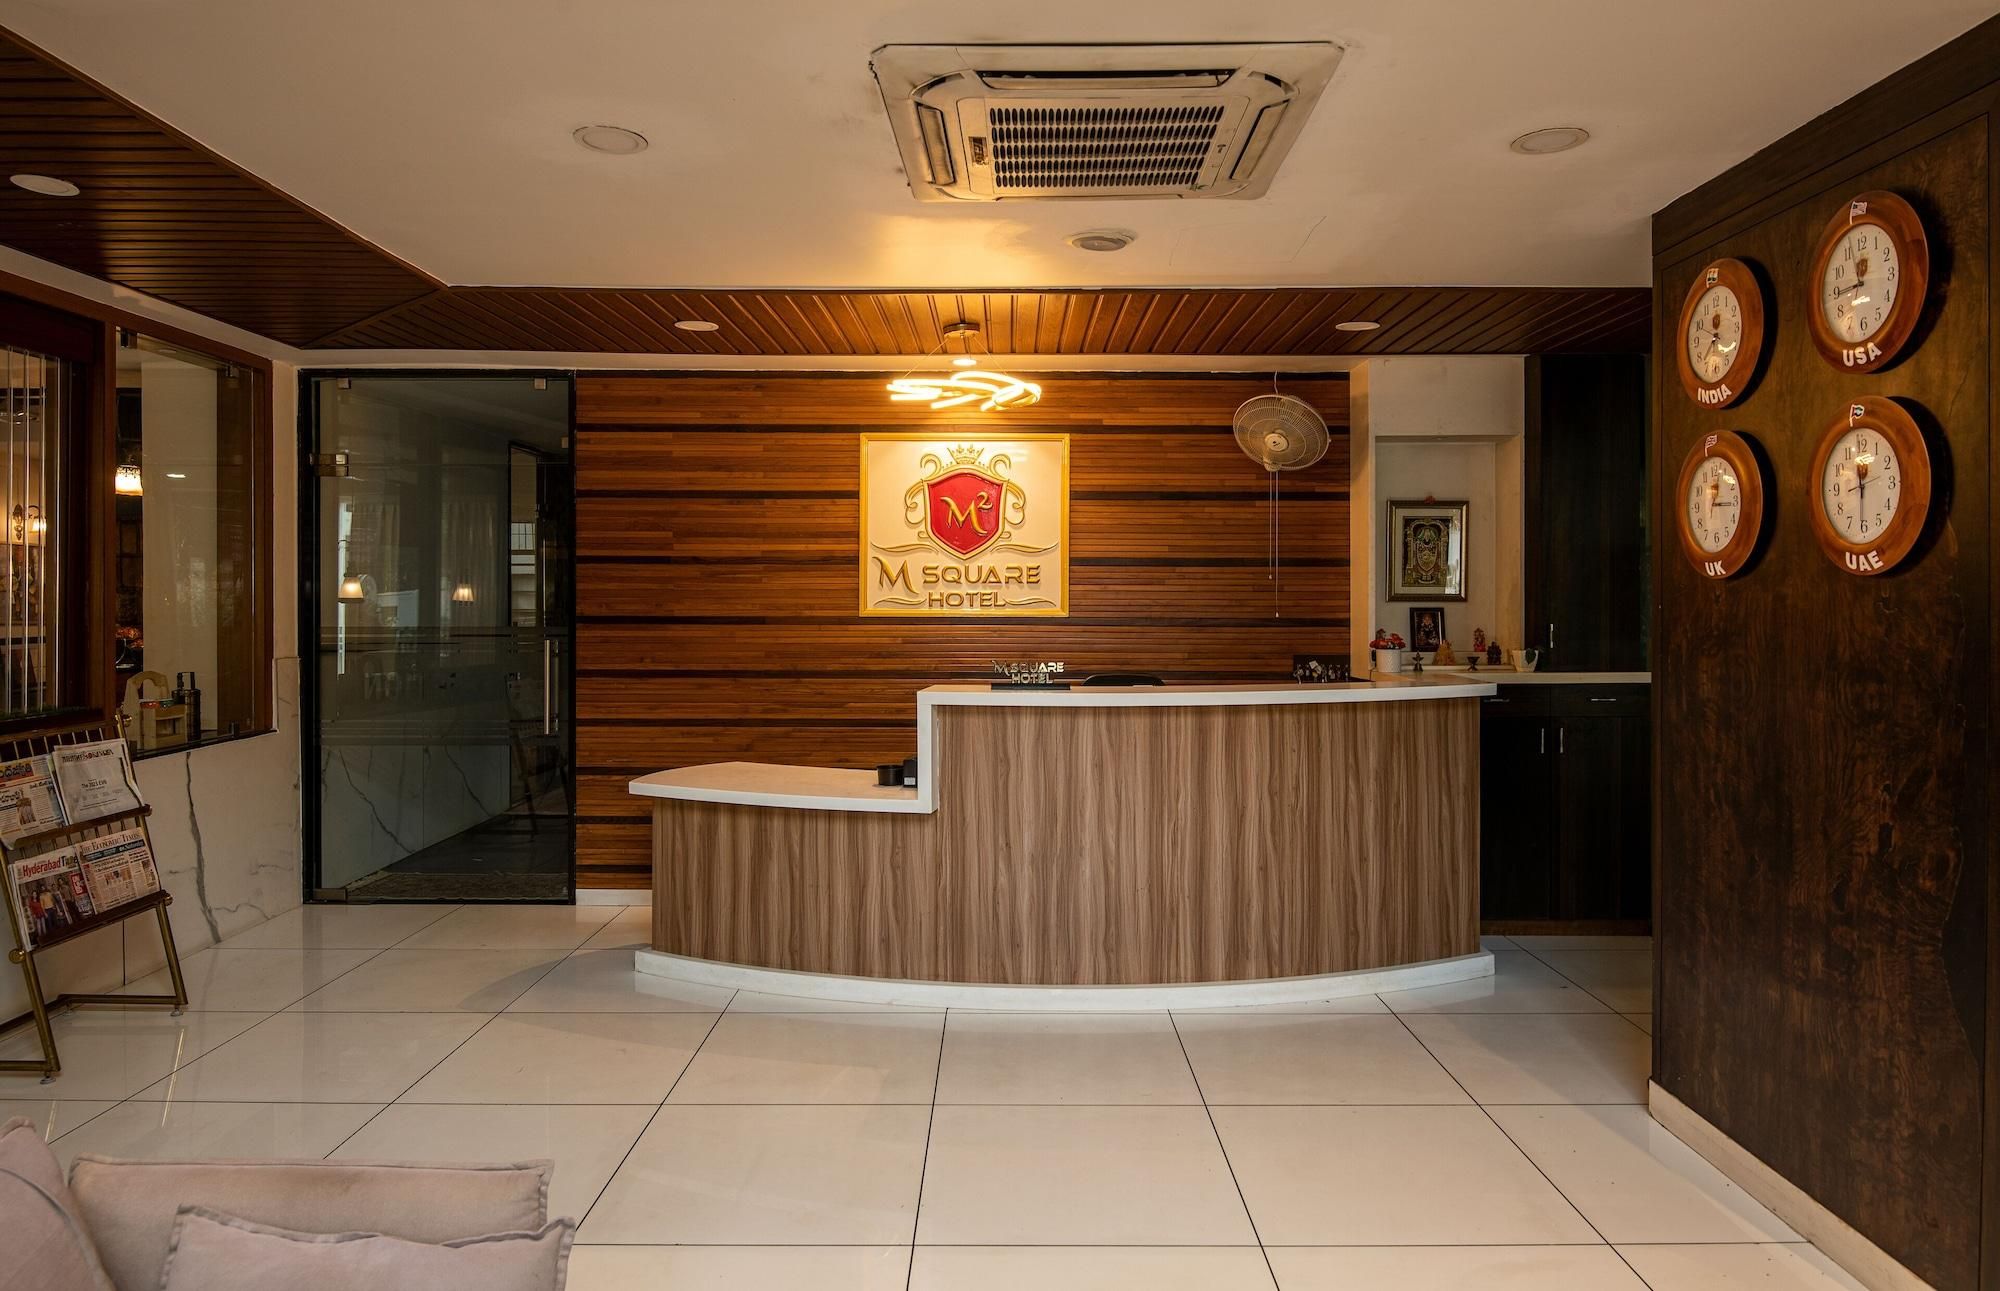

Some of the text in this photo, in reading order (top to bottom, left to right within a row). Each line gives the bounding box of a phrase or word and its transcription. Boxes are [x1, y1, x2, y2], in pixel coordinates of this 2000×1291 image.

[1857, 236, 1866, 251] 12
[1874, 236, 1877, 249] 1
[1844, 247, 1851, 261] 11
[1883, 247, 1890, 261] 2
[1835, 265, 1844, 280] 10
[1888, 267, 1894, 280] 3
[1833, 287, 1840, 299] 9
[1885, 290, 1890, 302] 4
[1713, 295, 1719, 307] 12
[1725, 296, 1728, 307] 1
[1704, 304, 1709, 315] 11
[1731, 306, 1736, 317] 2
[1837, 305, 1843, 318] 8
[1875, 308, 1881, 322] 5
[1696, 319, 1703, 331] 10
[1734, 322, 1739, 333] 3
[1860, 317, 1867, 331] 6
[1694, 338, 1699, 348] 9
[1697, 354, 1702, 362] 8
[1842, 342, 1882, 366] USA
[1724, 355, 1729, 366] 5
[1698, 384, 1732, 404] INDIA
[1858, 439, 1867, 453] 12
[1875, 442, 1878, 455] 1
[1845, 448, 1851, 460] 11
[1884, 456, 1890, 469] 2
[1711, 465, 1717, 477] 12
[1835, 463, 1844, 476] 10
[1703, 472, 1707, 483] 11
[1888, 477, 1895, 490] 3
[1696, 486, 1702, 497] 10
[1834, 483, 1840, 496] 9
[1733, 495, 1738, 507] 3
[1884, 498, 1890, 510] 4
[1694, 503, 1699, 513] 9
[1837, 503, 1843, 515] 8
[1698, 519, 1702, 529] 8
[1731, 513, 1735, 524] 4
[1846, 516, 1853, 530] 7
[1876, 514, 1881, 526] 5
[1724, 527, 1729, 538] 5
[1860, 520, 1867, 533] 6
[1704, 530, 1708, 541] 7
[1714, 532, 1719, 543] 6
[1846, 550, 1884, 571] UAE
[1705, 560, 1726, 576] UK
[872, 556, 1041, 595] M SQUARE
[928, 592, 1006, 608] HOTEL
[1011, 662, 1064, 673] SQUARE
[1011, 673, 1054, 684] HOTEL
[92, 837, 120, 850] ECONOMIC
[23, 857, 61, 877] Hyderabad
